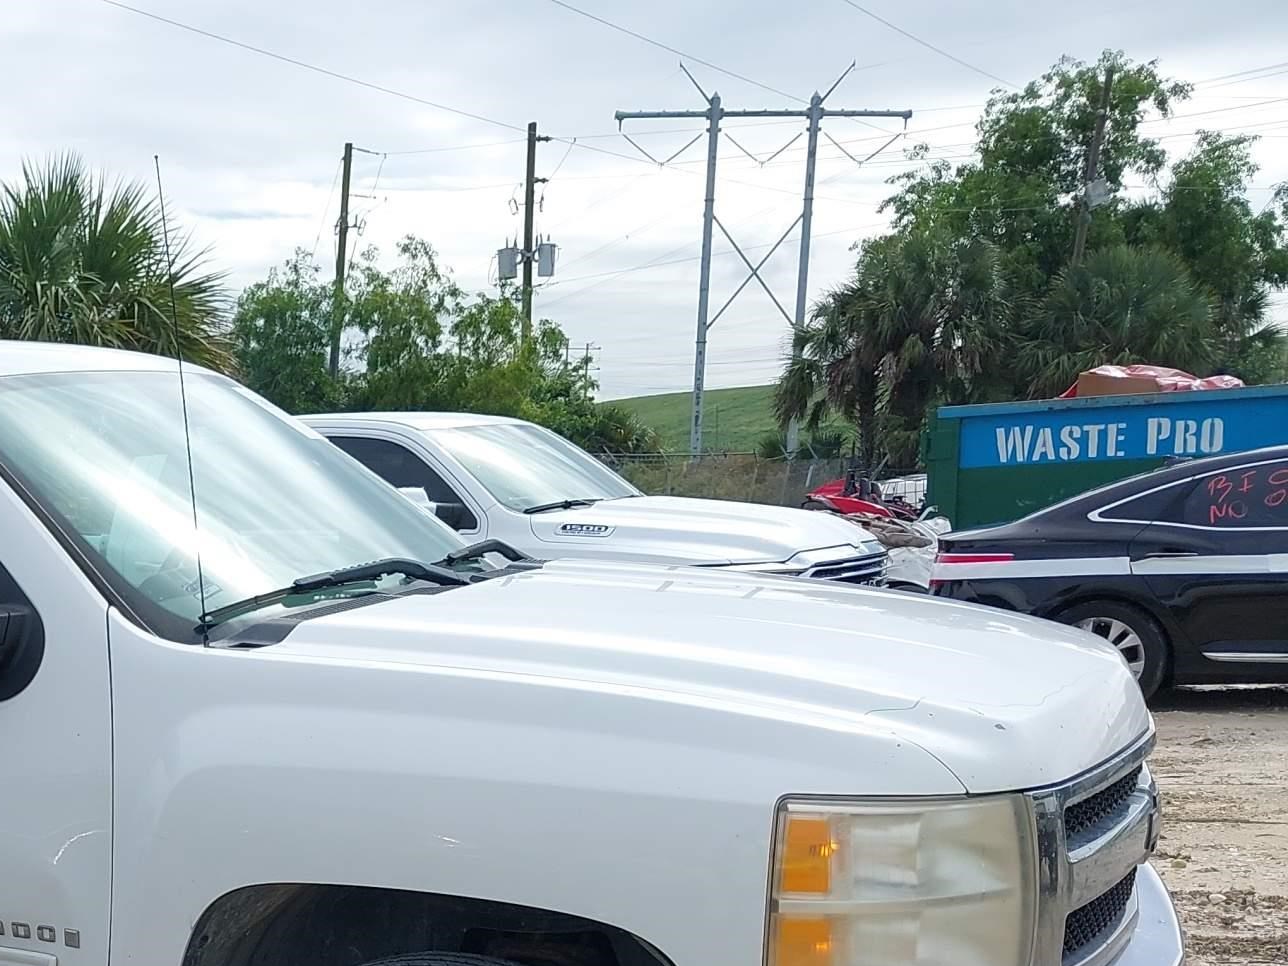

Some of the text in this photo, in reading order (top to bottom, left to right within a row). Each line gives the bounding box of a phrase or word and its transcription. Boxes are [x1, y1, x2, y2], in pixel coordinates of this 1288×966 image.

[996, 417, 1224, 463] WASTE PRO
[559, 524, 607, 532] 1500
